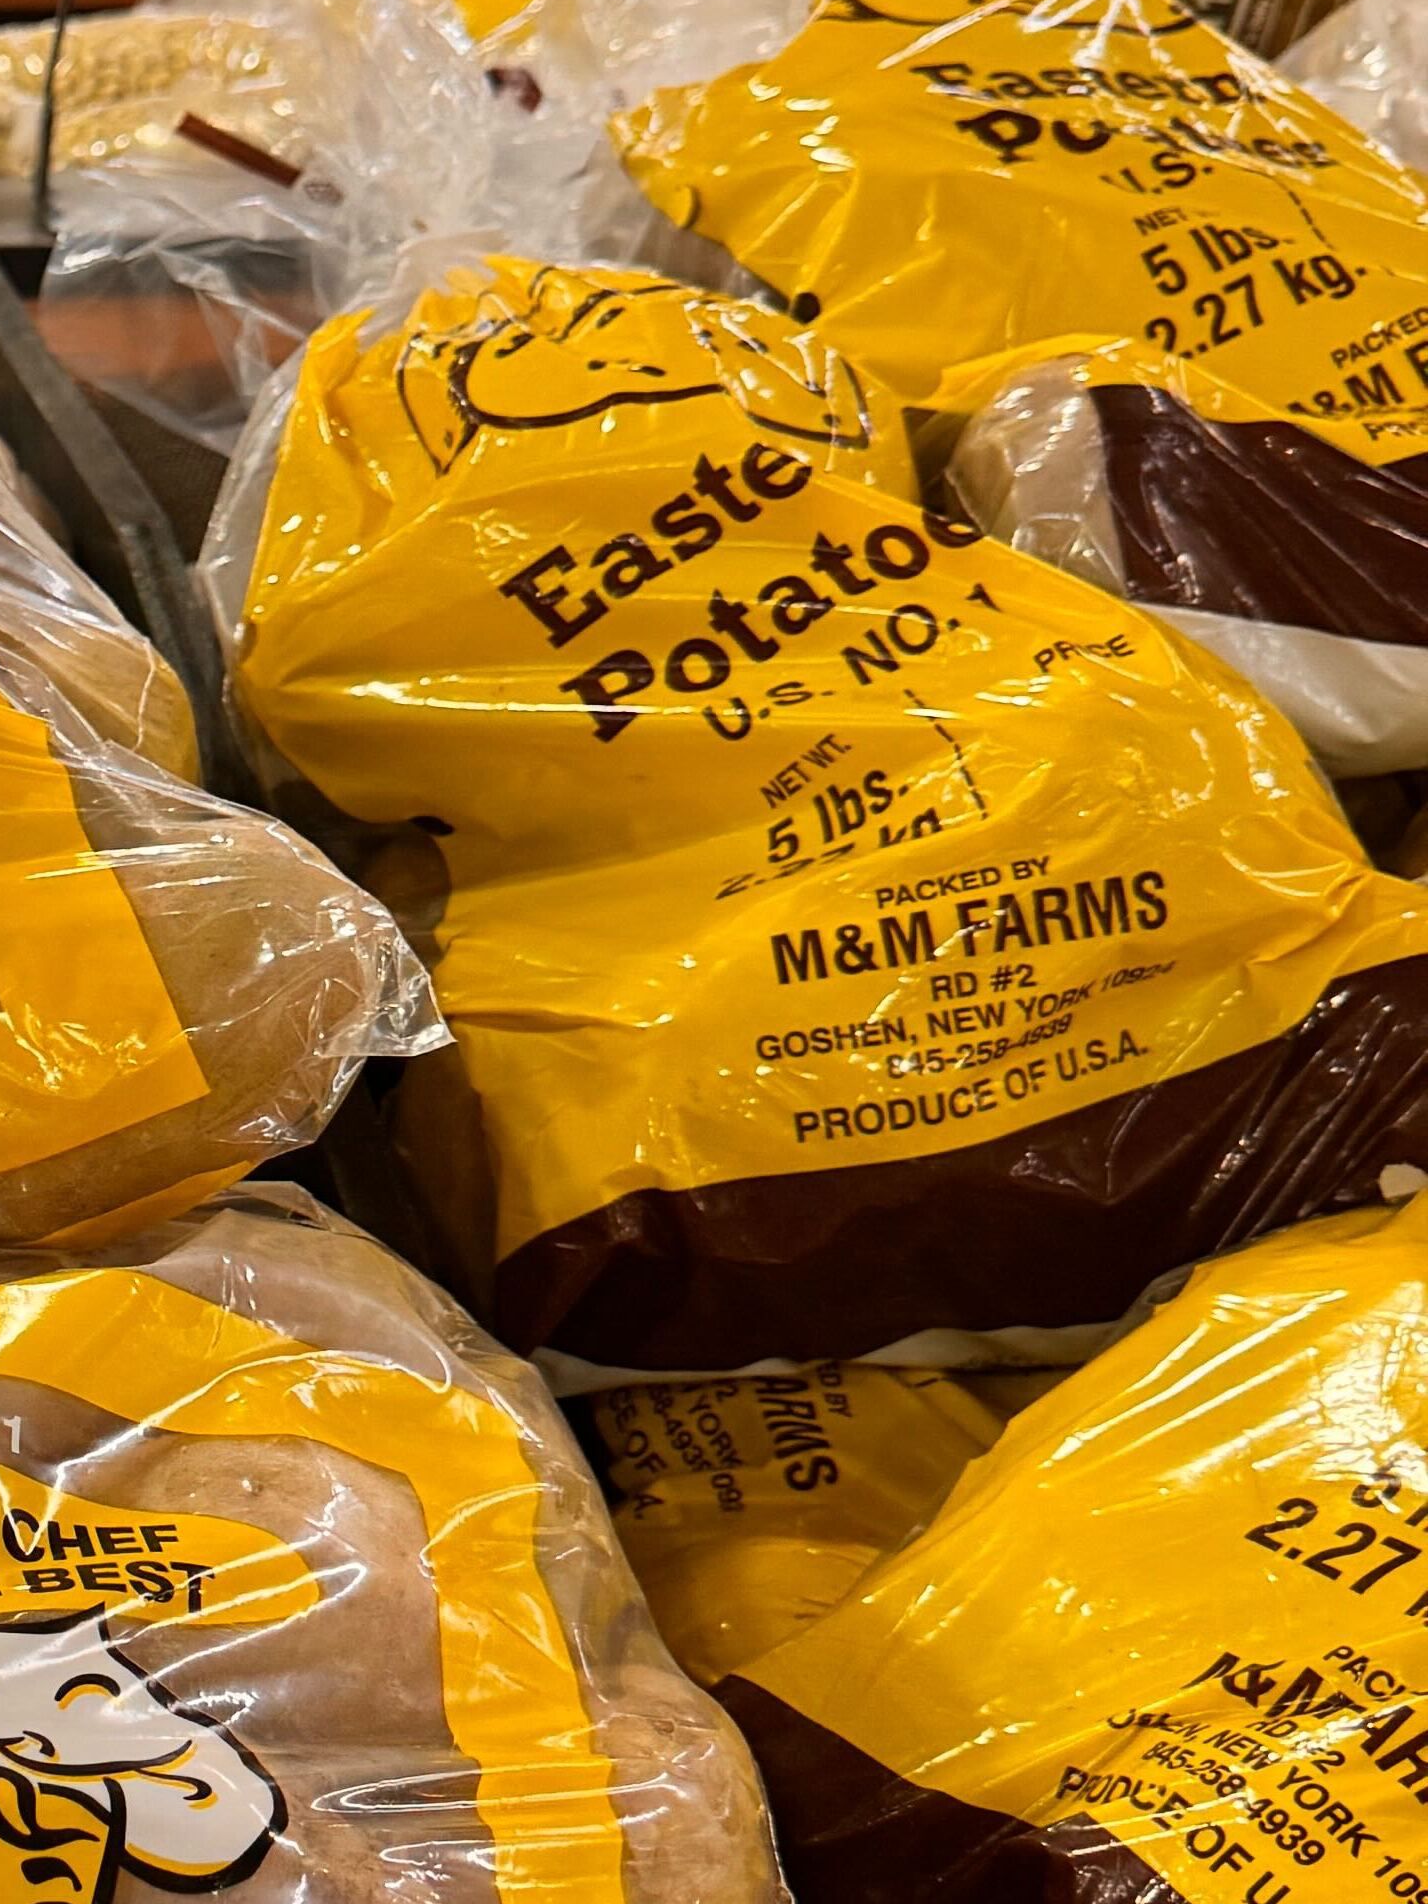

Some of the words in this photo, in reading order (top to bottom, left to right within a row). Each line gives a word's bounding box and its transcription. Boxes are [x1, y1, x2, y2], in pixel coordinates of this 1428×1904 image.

[1133, 210, 1190, 236] NET
[1141, 244, 1188, 296] 5
[1194, 221, 1297, 273] lbs.
[1146, 274, 1265, 360] 2.27
[1274, 256, 1367, 306] kg.
[700, 675, 835, 743] U.S.
[845, 605, 962, 687] NO.
[760, 760, 812, 809] NET
[802, 734, 852, 770] WT.
[766, 817, 800, 864] 5
[812, 770, 911, 844] lbs.
[875, 867, 1001, 909] PACKED
[1011, 856, 1051, 882] BY
[770, 909, 939, 985] M&M
[955, 869, 1170, 957] FARMS
[755, 1017, 919, 1062] GOSHEN,
[927, 1001, 1006, 1039] NEW
[1015, 981, 1094, 1022] YORK
[1099, 959, 1177, 993] 10924
[930, 970, 978, 1002] RD
[990, 963, 1039, 992] #2
[886, 1013, 1073, 1080] 845-258-4939
[793, 1078, 999, 1144] PRODUCE
[1003, 1059, 1047, 1101] OF
[1055, 1028, 1150, 1081] U.S.A.
[2, 1416, 23, 1456] 1
[1, 1507, 180, 1564] CHEF
[1244, 1497, 1422, 1595] 2.27
[23, 1559, 215, 1615] BEST
[1202, 1727, 1281, 1771] NEW
[1276, 1765, 1381, 1859] YORK
[1184, 1822, 1254, 1874] OF
